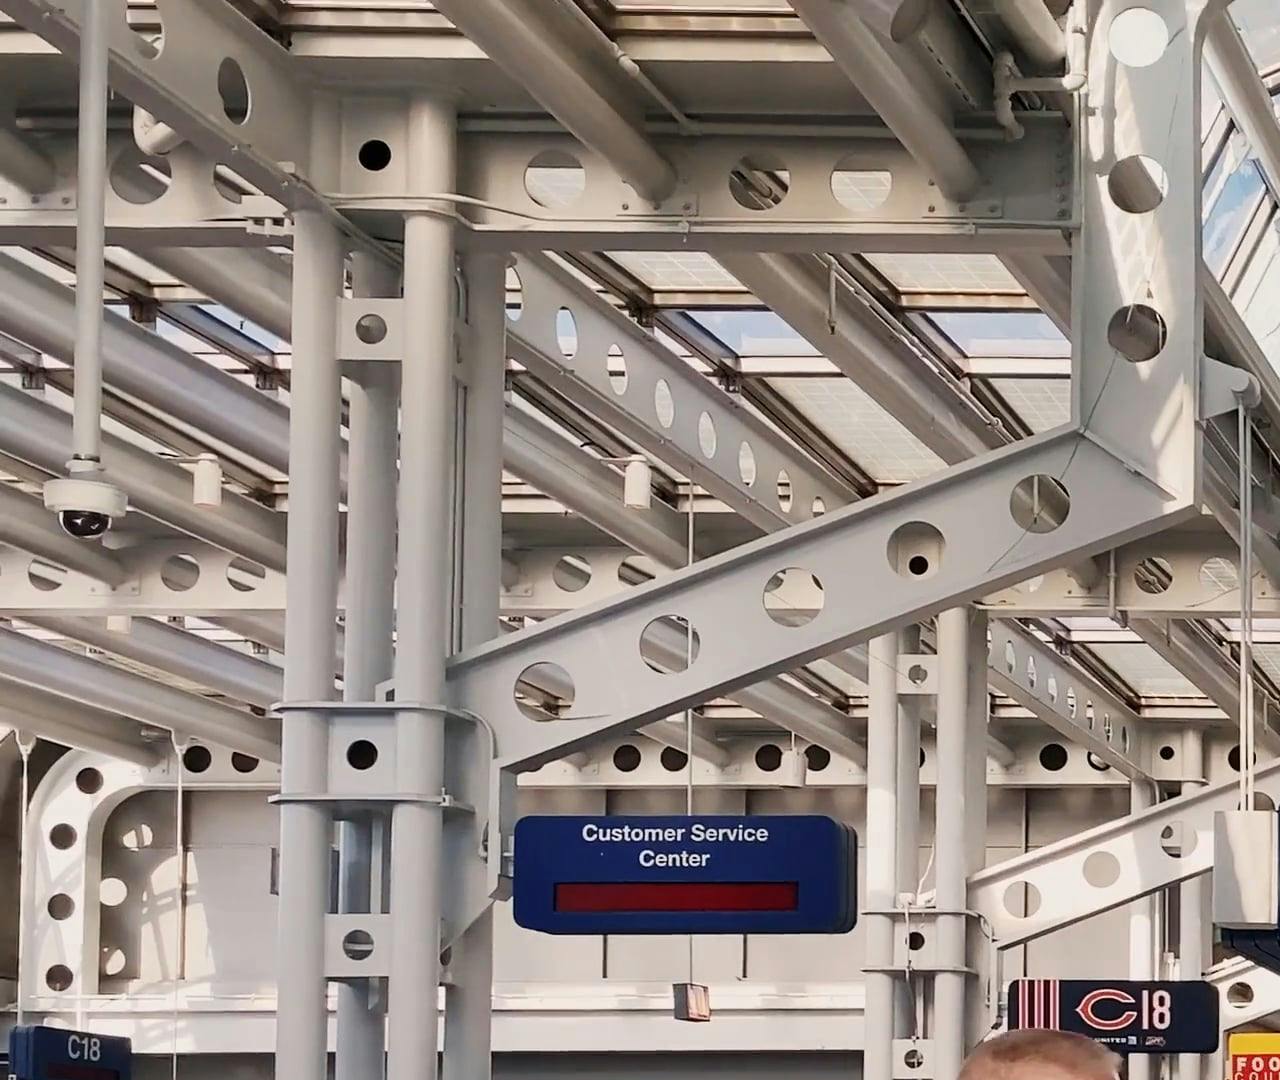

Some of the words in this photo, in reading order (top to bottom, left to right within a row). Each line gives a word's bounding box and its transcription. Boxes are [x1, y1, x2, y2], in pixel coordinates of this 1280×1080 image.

[582, 823, 686, 842] Customer
[690, 824, 769, 842] Service
[638, 849, 711, 868] Center
[68, 1034, 101, 1062] C18
